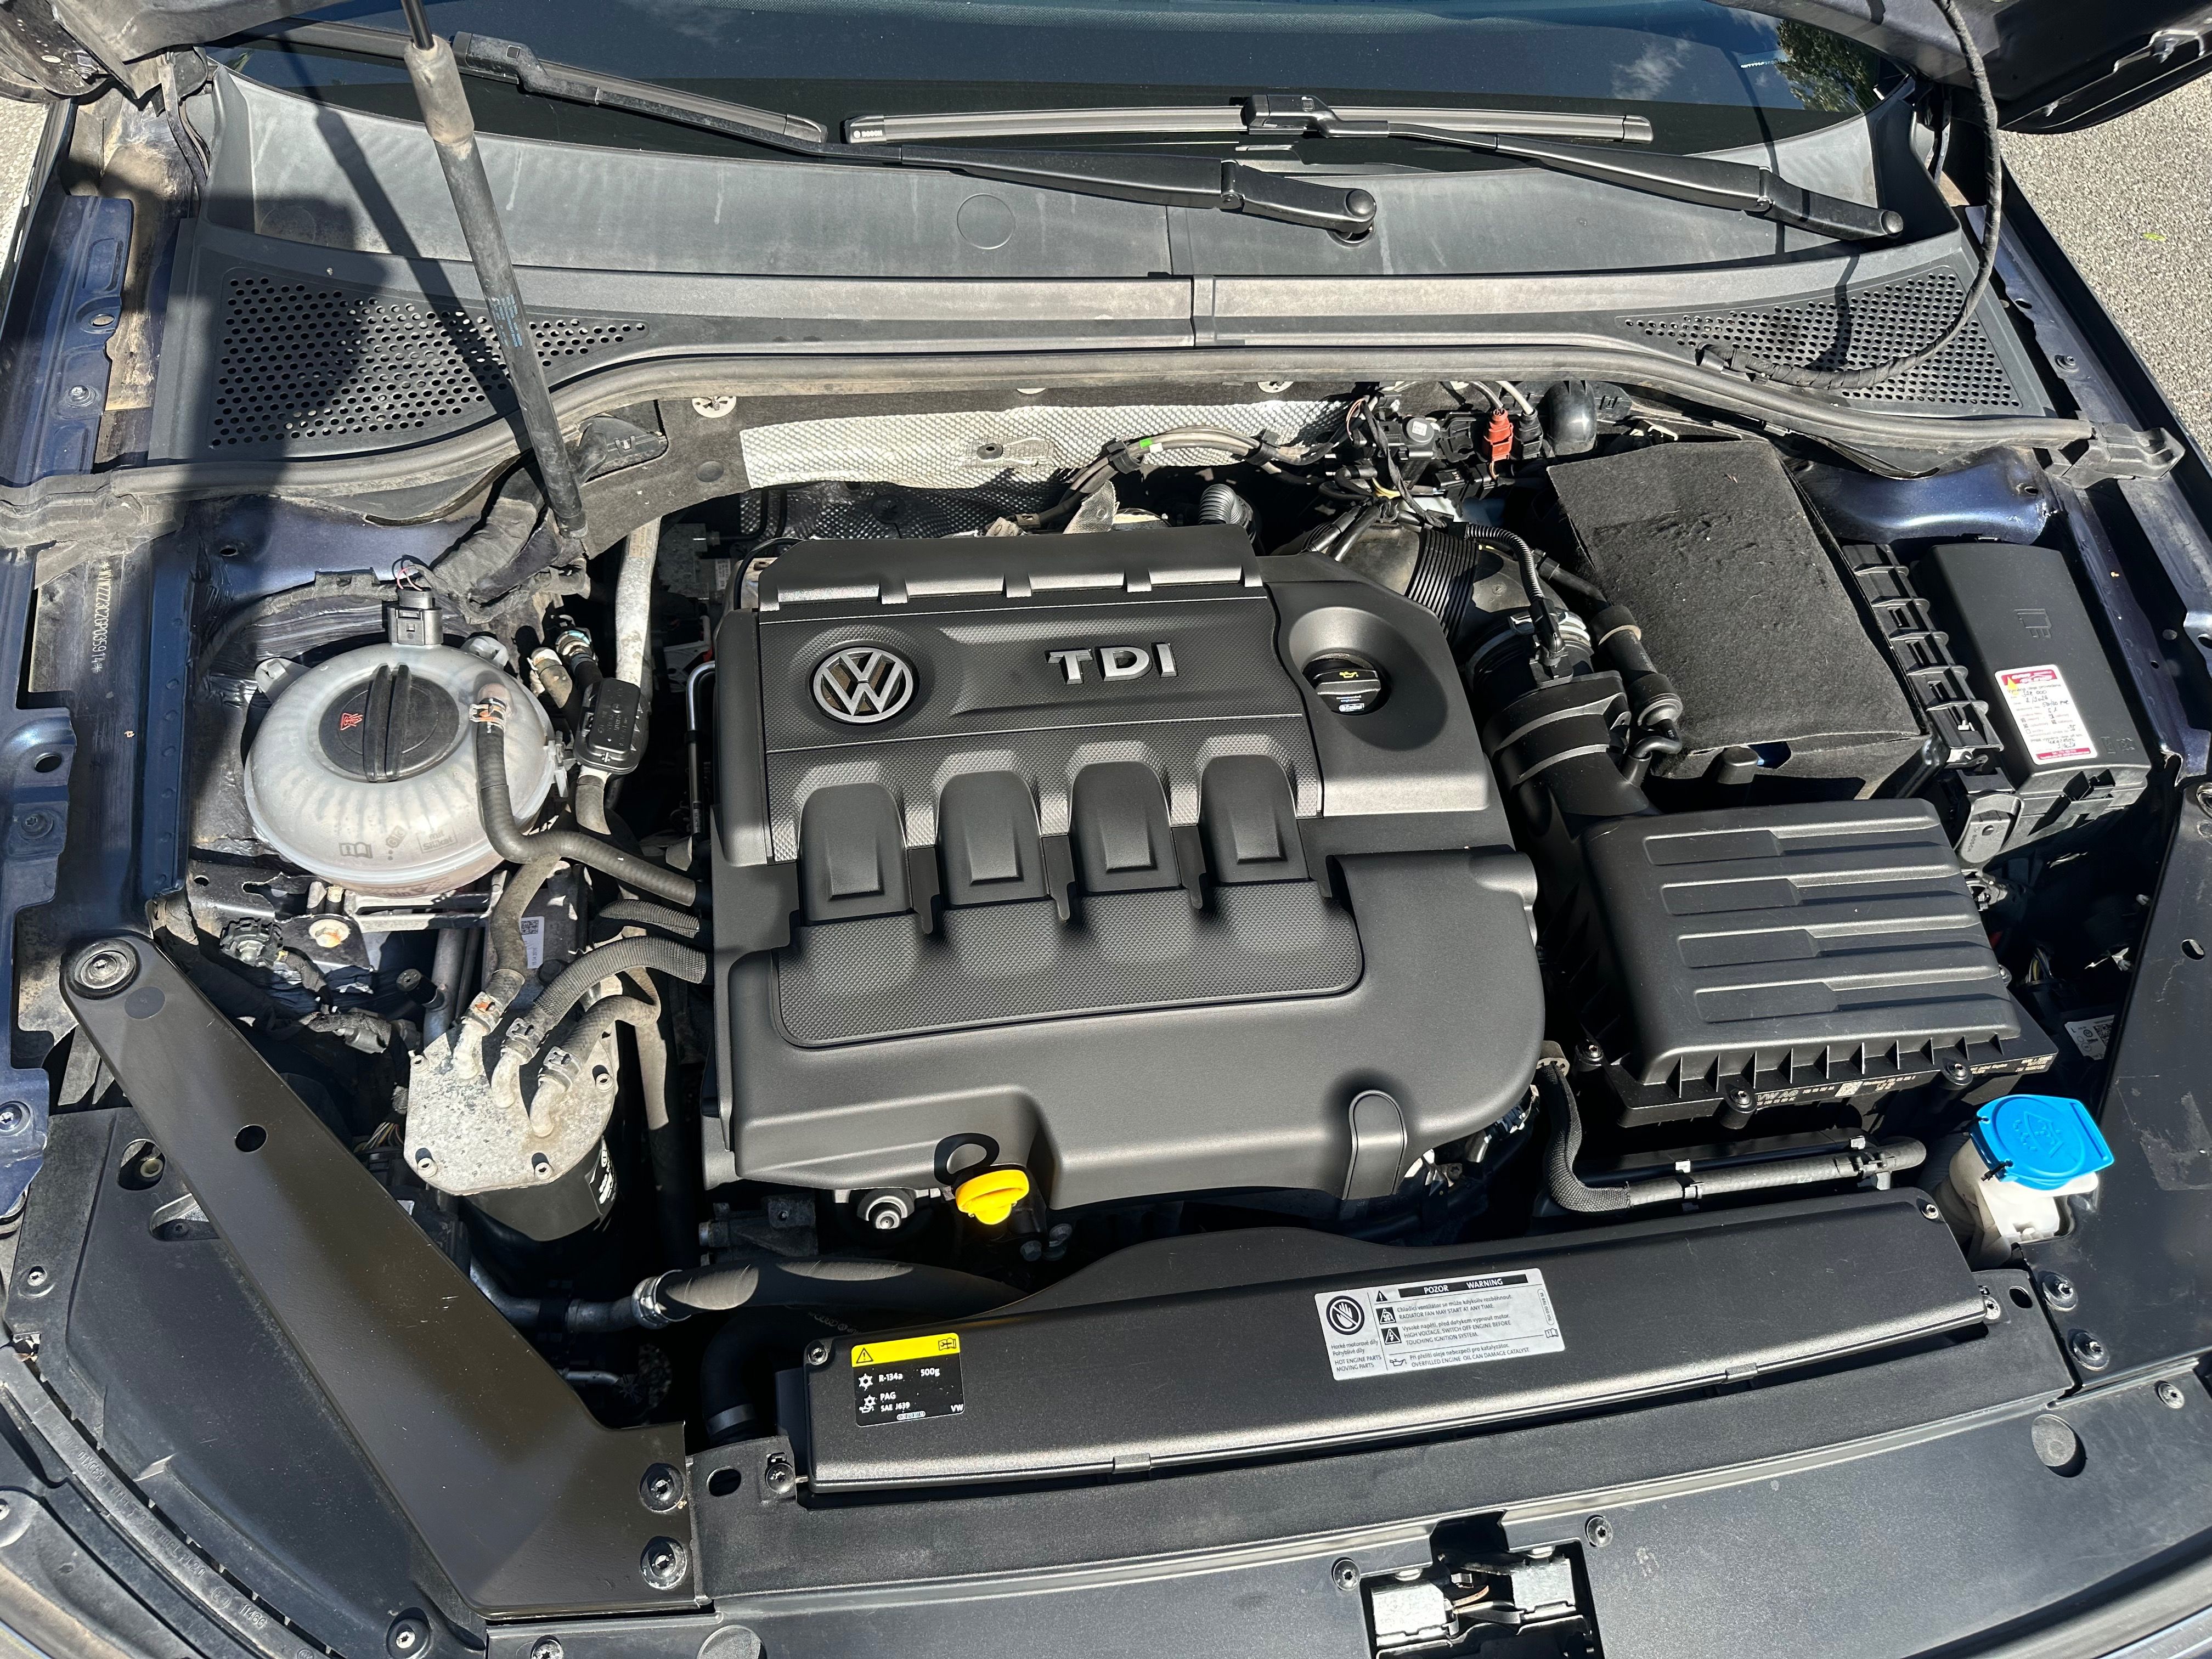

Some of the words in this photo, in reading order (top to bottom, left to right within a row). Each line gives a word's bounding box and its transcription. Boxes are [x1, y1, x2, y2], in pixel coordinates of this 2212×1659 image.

[1045, 642, 1178, 685] TDI
[1757, 1092, 1779, 1102] VW
[1778, 1090, 1799, 1099] AG
[1424, 1285, 1449, 1294] POZOR
[1466, 1278, 1503, 1289] WARNING
[1450, 1318, 1472, 1326] dotykem
[879, 1373, 903, 1382] R-134a
[921, 1368, 940, 1377] 500g
[880, 1392, 896, 1401] PAG
[881, 1404, 893, 1412] SAE
[895, 1401, 911, 1410] J639
[950, 1403, 964, 1412] VW
[239, 1603, 267, 1628] 11466
